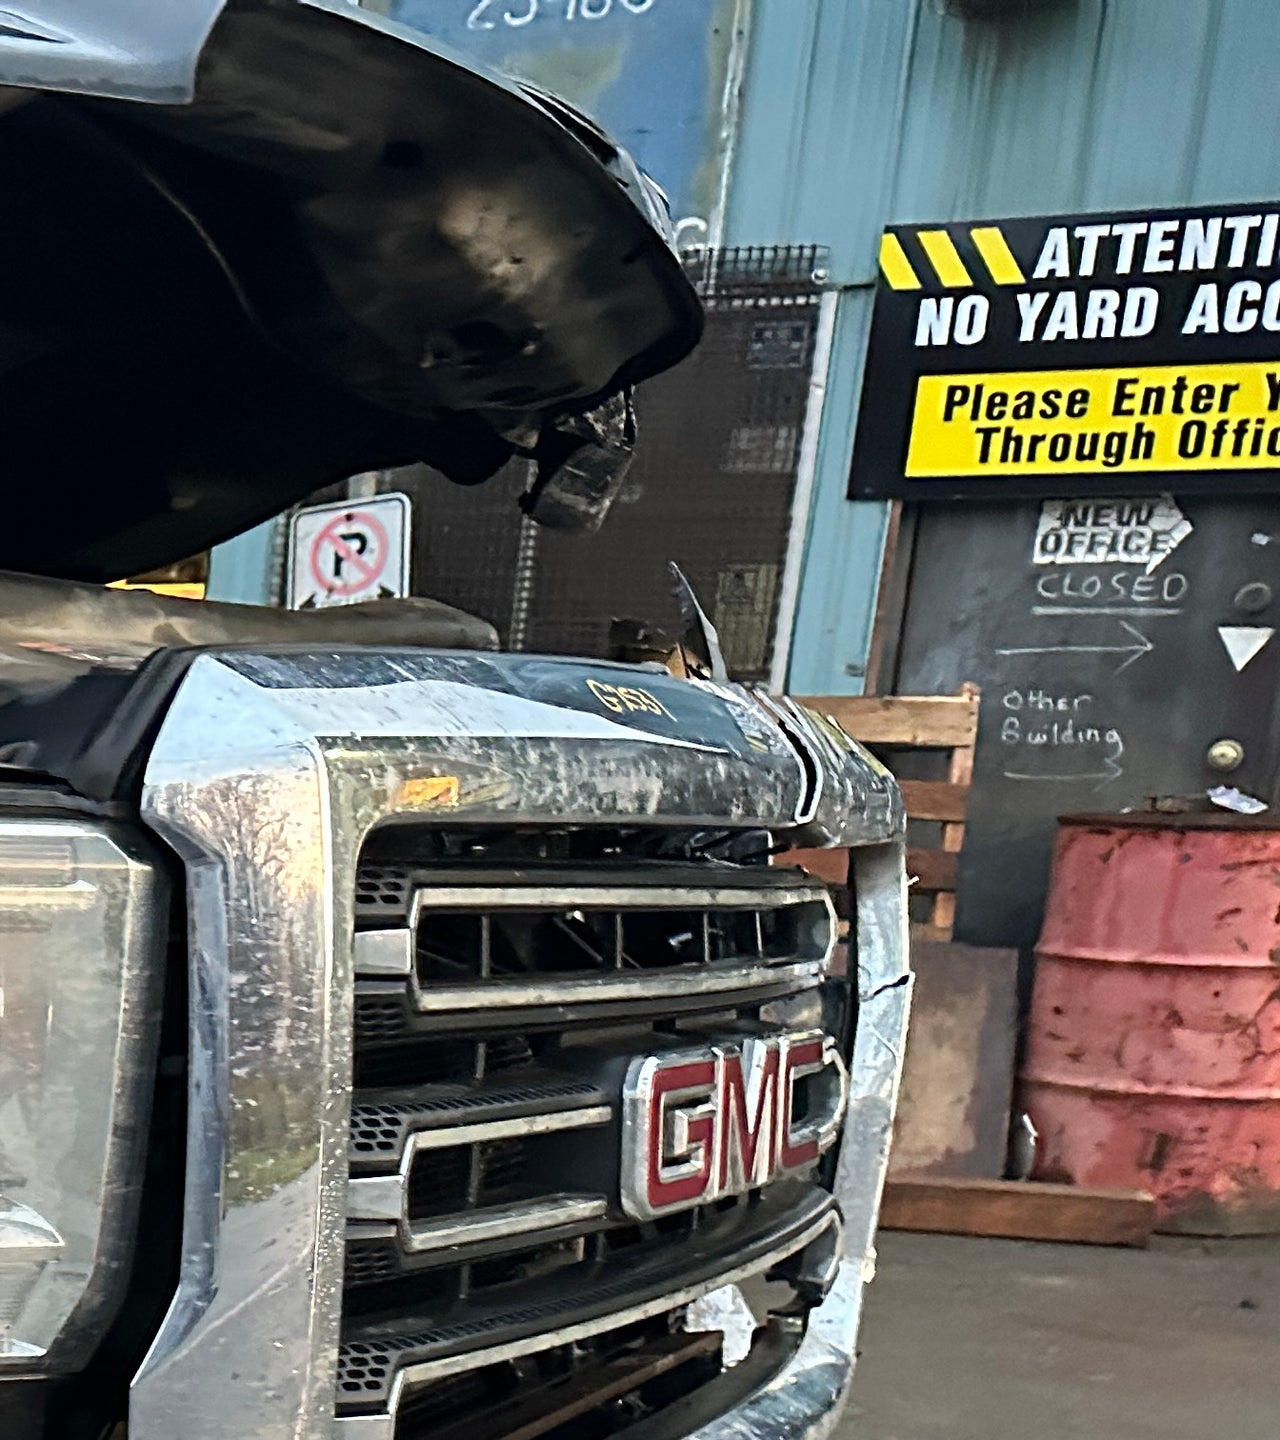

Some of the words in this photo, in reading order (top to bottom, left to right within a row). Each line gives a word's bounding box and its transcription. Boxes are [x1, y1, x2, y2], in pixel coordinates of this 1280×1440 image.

[1032, 213, 1280, 280] ATTENTI
[914, 294, 990, 346] NO
[1016, 286, 1159, 342] YARD
[943, 383, 1090, 422] Please
[1112, 375, 1240, 417] Enter
[974, 421, 1155, 468] Through
[1060, 502, 1153, 528] NEW
[1037, 572, 1188, 602] CLOSED
[1002, 689, 1093, 712] Other
[1001, 716, 1124, 762] Building
[621, 1028, 849, 1221] GMC
